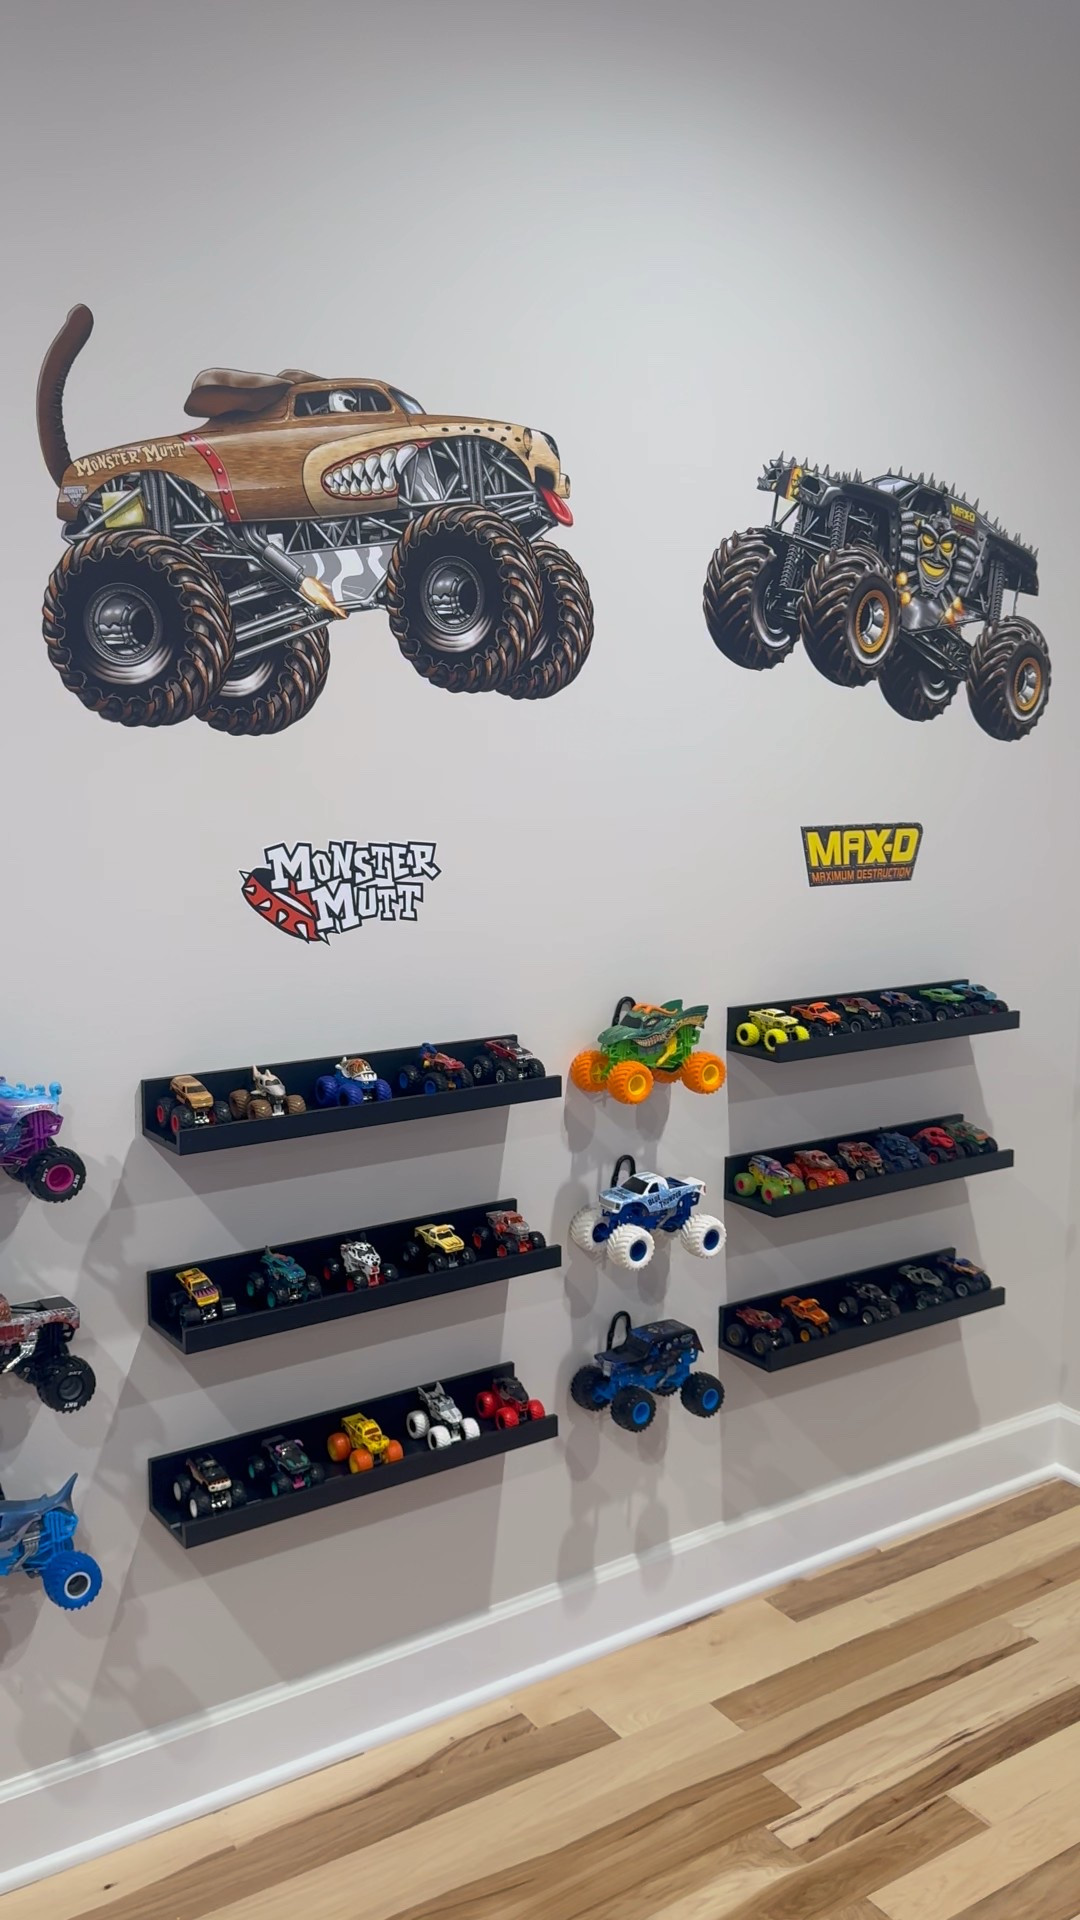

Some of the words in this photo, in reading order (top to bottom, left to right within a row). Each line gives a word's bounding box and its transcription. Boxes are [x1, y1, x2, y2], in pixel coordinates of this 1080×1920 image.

[73, 450, 140, 477] MONSTER
[142, 442, 185, 463] MUTT
[264, 841, 442, 891] MONSTER
[806, 827, 919, 867] MAX-D
[811, 870, 854, 883] MAXIMUM
[856, 867, 911, 879] DESTRUCTION
[311, 880, 424, 932] MUTT
